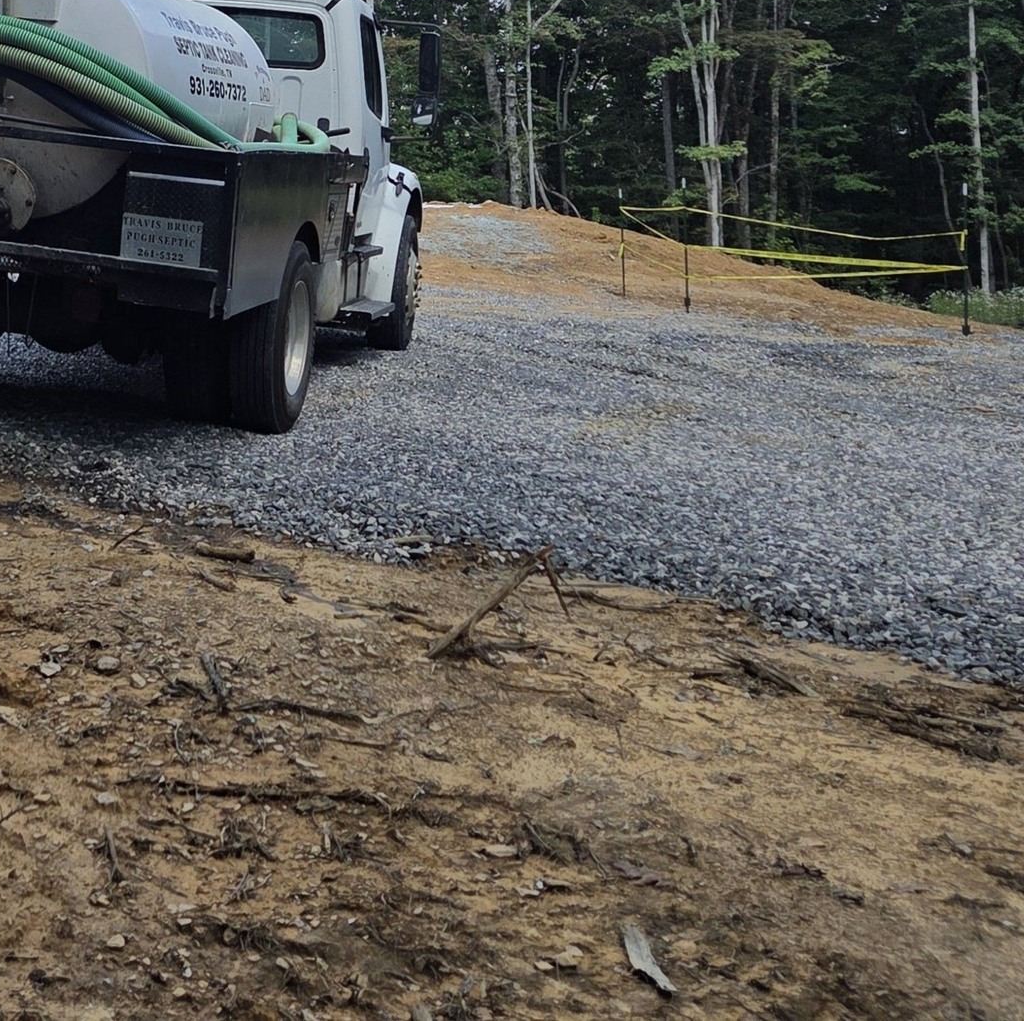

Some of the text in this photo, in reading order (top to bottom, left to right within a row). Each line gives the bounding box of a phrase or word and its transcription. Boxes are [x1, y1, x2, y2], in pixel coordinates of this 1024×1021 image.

[173, 35, 249, 68] SEPTIC TANK CLEANING
[189, 75, 247, 102] 931-260-7372
[123, 216, 203, 234] TRAVIS BRUCE
[126, 231, 196, 248] PUGH SEPTIC
[137, 248, 184, 262] 261-5322
